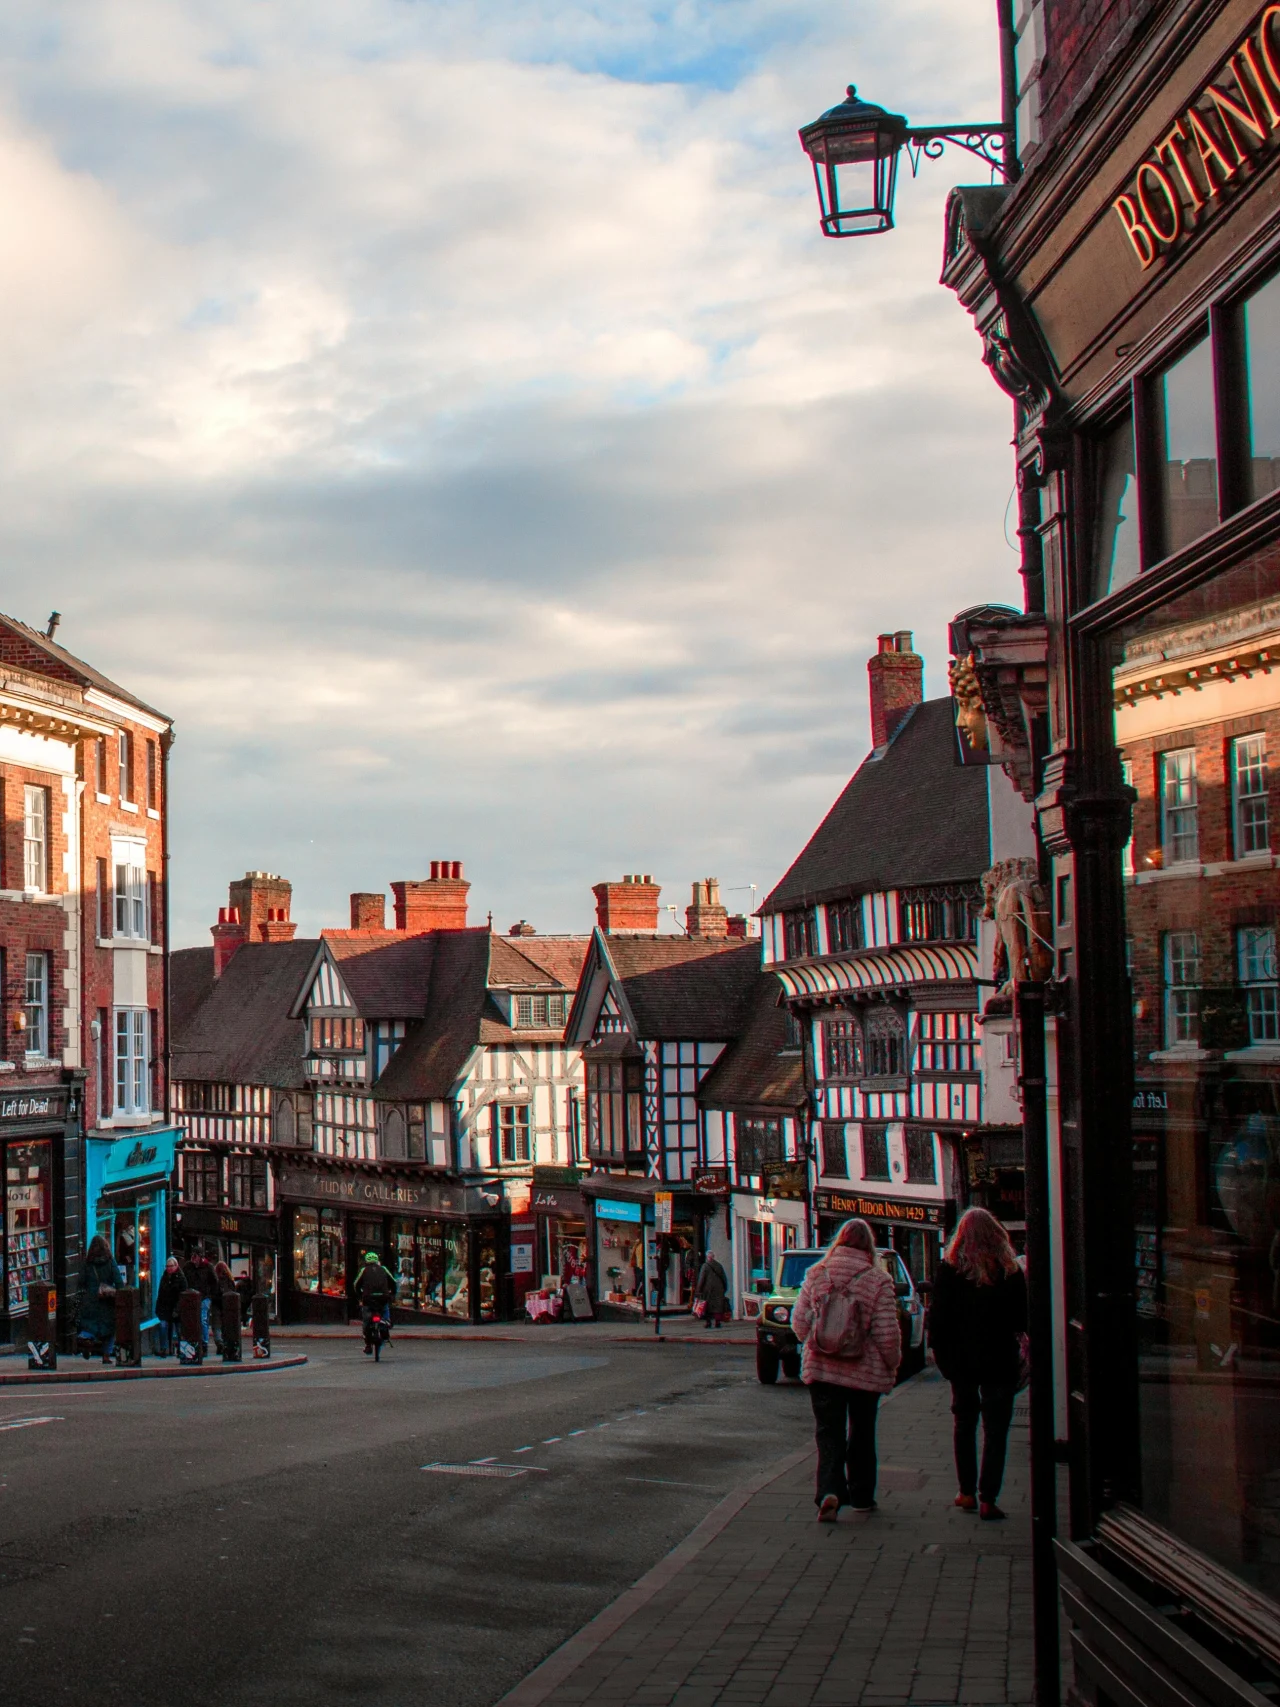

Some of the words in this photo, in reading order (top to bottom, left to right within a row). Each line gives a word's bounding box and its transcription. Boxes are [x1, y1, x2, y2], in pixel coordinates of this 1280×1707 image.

[1, 1100, 17, 1116] Left
[18, 1099, 29, 1115] for
[29, 1097, 49, 1115] Dead
[320, 1180, 354, 1196] TUDOR
[364, 1184, 419, 1203] GALLERIES
[535, 1193, 546, 1205] La
[546, 1194, 557, 1206] Vie
[831, 1194, 857, 1213] HENRY
[857, 1198, 885, 1216] TUDOR
[885, 1201, 901, 1217] INN
[905, 1206, 924, 1220] 1429
